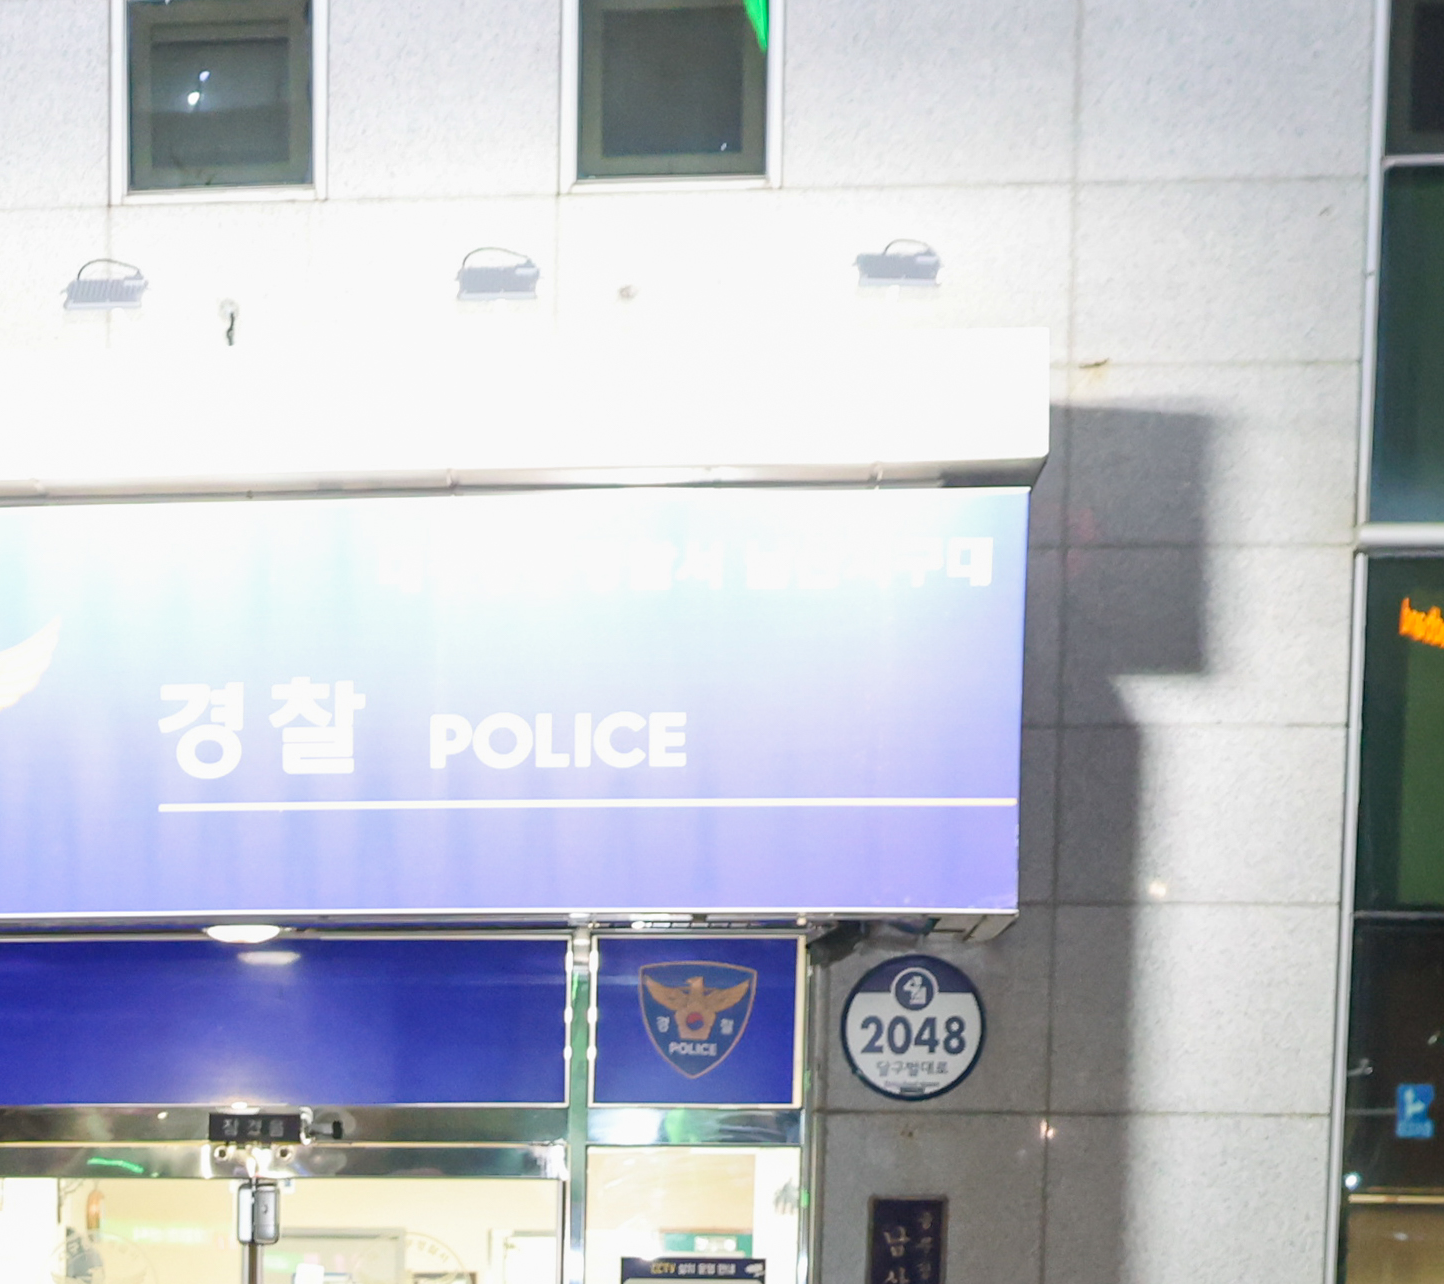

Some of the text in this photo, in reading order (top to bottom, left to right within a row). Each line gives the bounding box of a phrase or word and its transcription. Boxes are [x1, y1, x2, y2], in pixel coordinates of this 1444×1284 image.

[157, 677, 689, 781] 경찰 POLICE
[668, 1041, 717, 1057] POLICE
[860, 1015, 966, 1055] 2048
